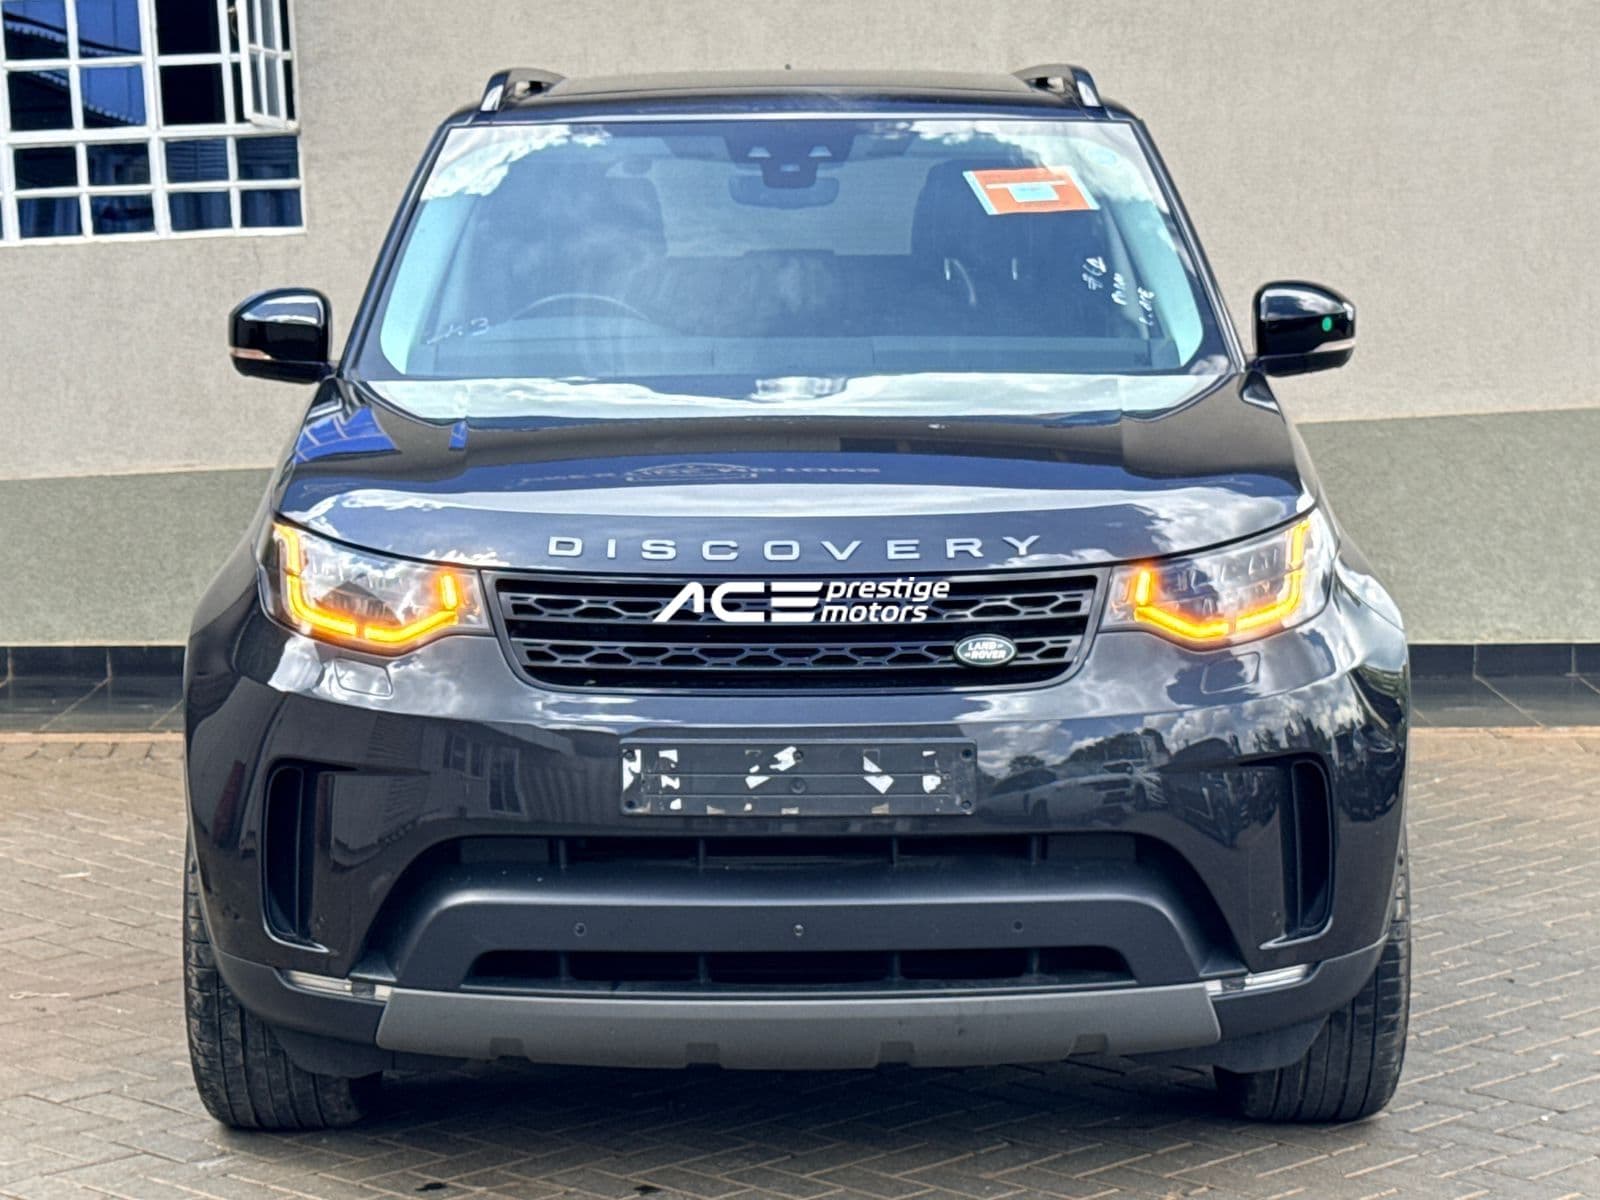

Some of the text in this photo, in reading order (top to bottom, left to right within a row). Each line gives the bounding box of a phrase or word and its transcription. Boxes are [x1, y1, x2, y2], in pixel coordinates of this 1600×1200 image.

[547, 535, 1041, 561] DISCOVERY
[968, 641, 997, 651] LAND
[970, 649, 1007, 660] ROVER
